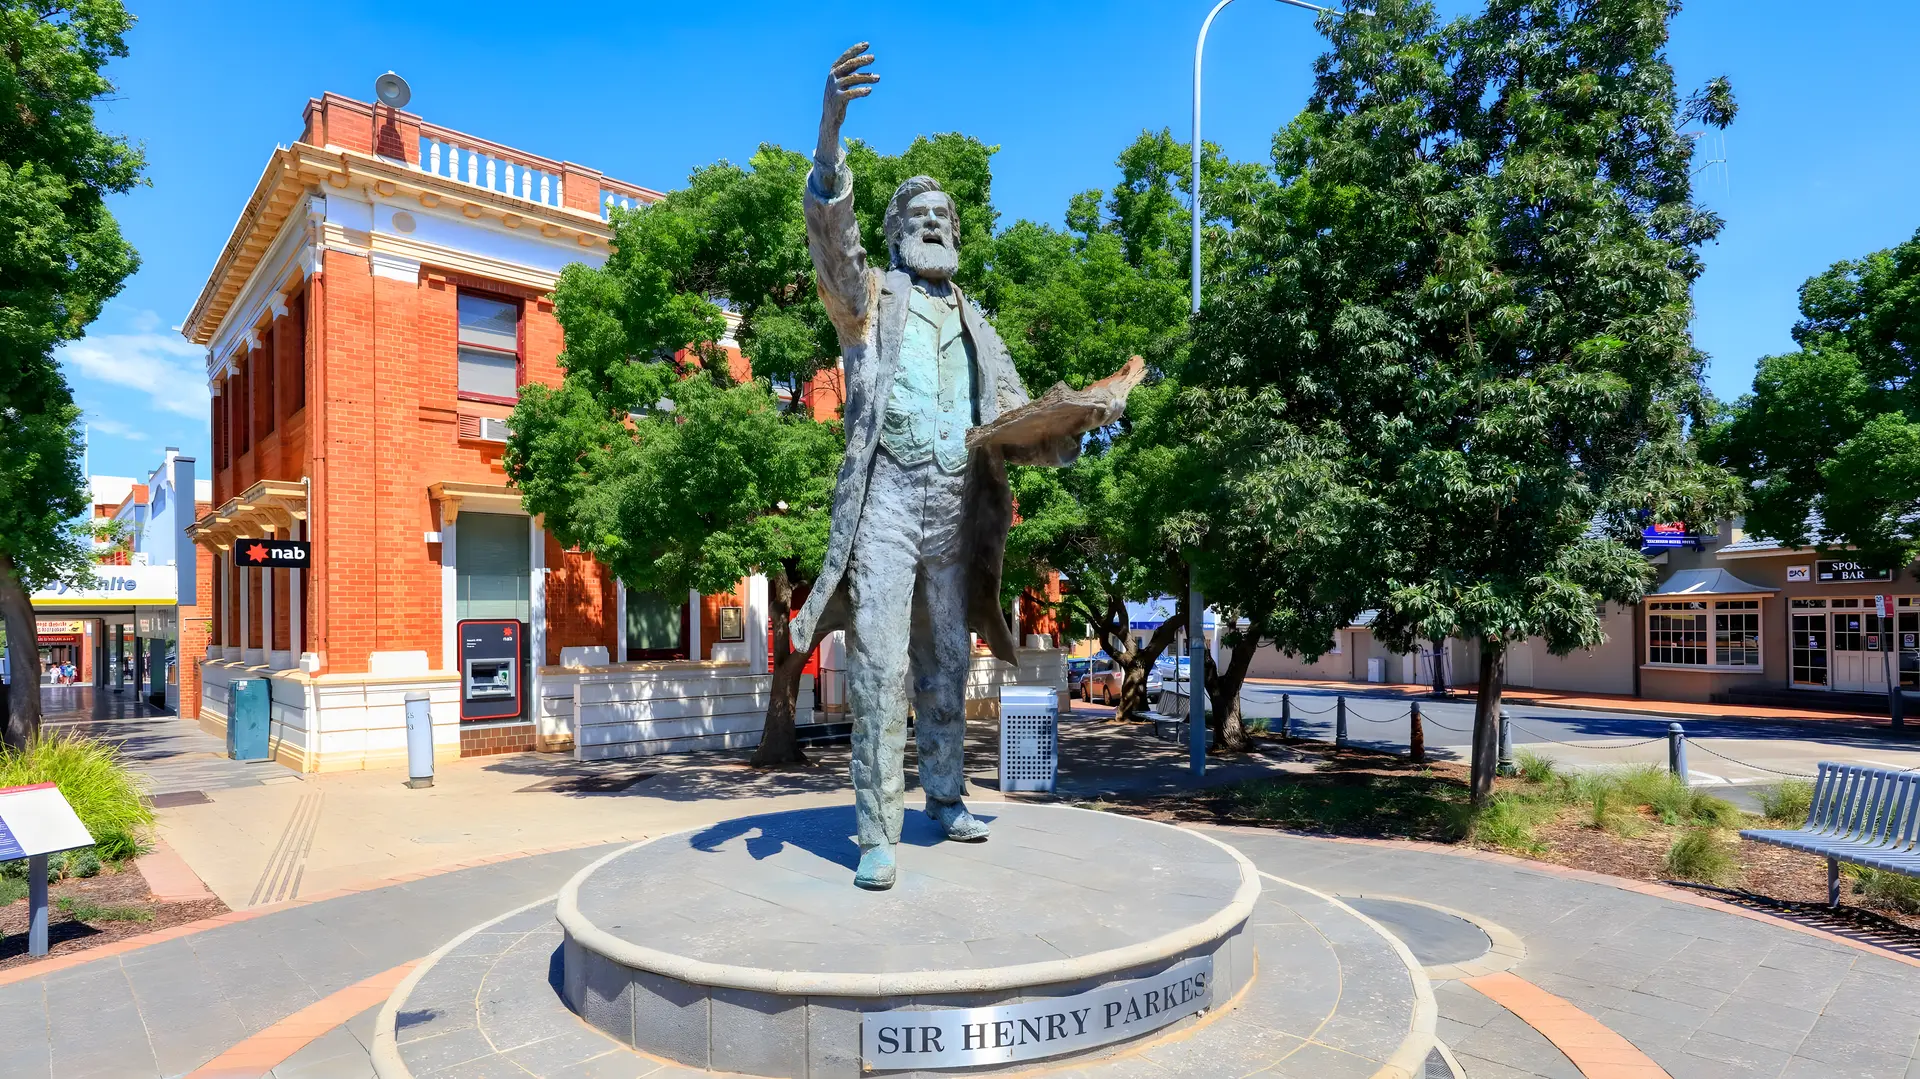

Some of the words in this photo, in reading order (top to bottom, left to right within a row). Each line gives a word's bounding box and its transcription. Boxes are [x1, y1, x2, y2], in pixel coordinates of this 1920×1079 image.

[271, 546, 306, 560] nab
[1789, 568, 1807, 577] SKY
[1842, 571, 1865, 580] BAR
[86, 577, 137, 591] hite
[878, 1026, 945, 1054] SIR
[961, 1007, 1091, 1051] HENRY
[1104, 971, 1207, 1029] PARKES
